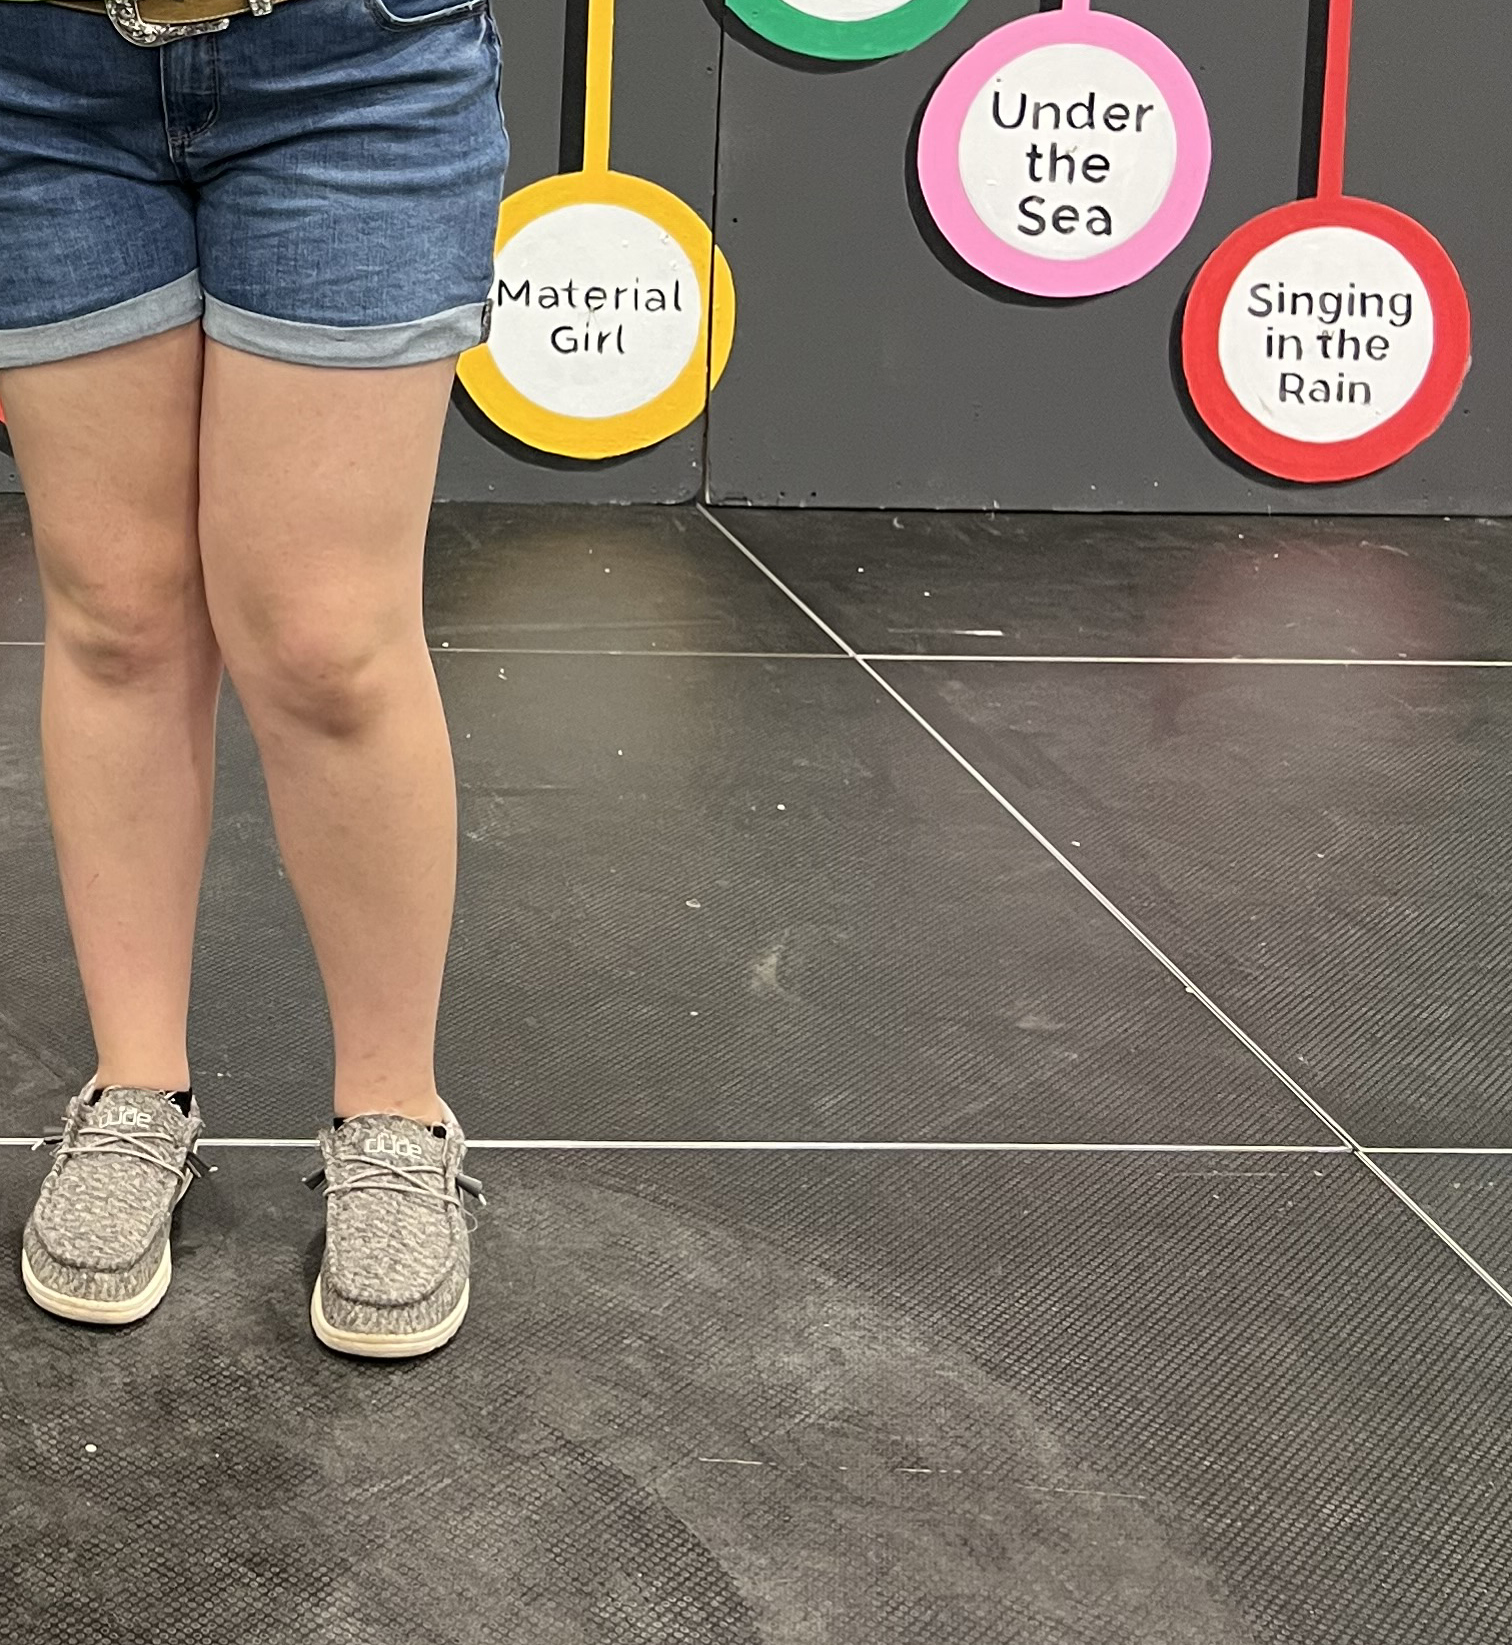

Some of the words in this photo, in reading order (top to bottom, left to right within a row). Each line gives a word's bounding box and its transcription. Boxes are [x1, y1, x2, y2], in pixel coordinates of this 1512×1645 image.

[991, 91, 1154, 133] Under
[1025, 142, 1111, 185] the
[1017, 194, 1112, 236] Sea
[497, 277, 683, 312] Material
[1247, 282, 1413, 327] Singing
[550, 322, 625, 354] Girl
[1265, 326, 1303, 360] in
[1316, 328, 1391, 361] the
[1278, 372, 1372, 405] Rain
